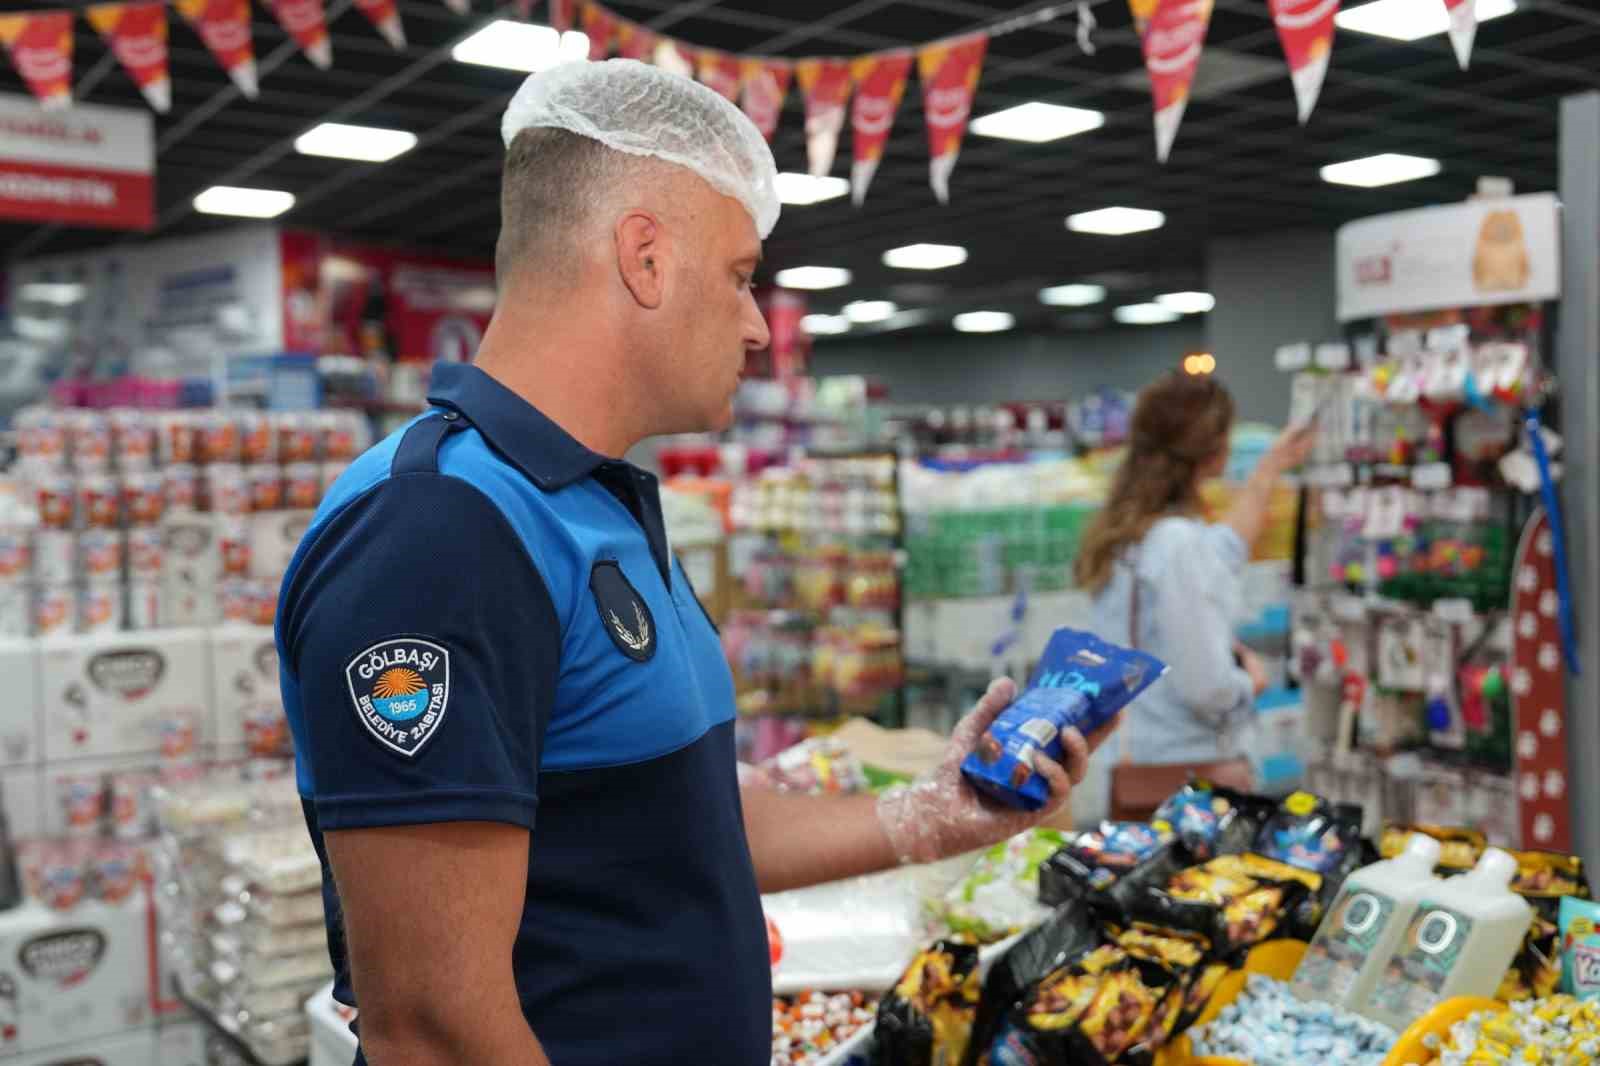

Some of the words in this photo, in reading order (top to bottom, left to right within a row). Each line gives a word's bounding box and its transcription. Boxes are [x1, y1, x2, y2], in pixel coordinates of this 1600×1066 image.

[358, 648, 440, 678] GÖLBAŞI
[359, 694, 408, 744] BELEDİYE
[410, 683, 444, 740] ZABITASI
[388, 700, 417, 714] 1965
